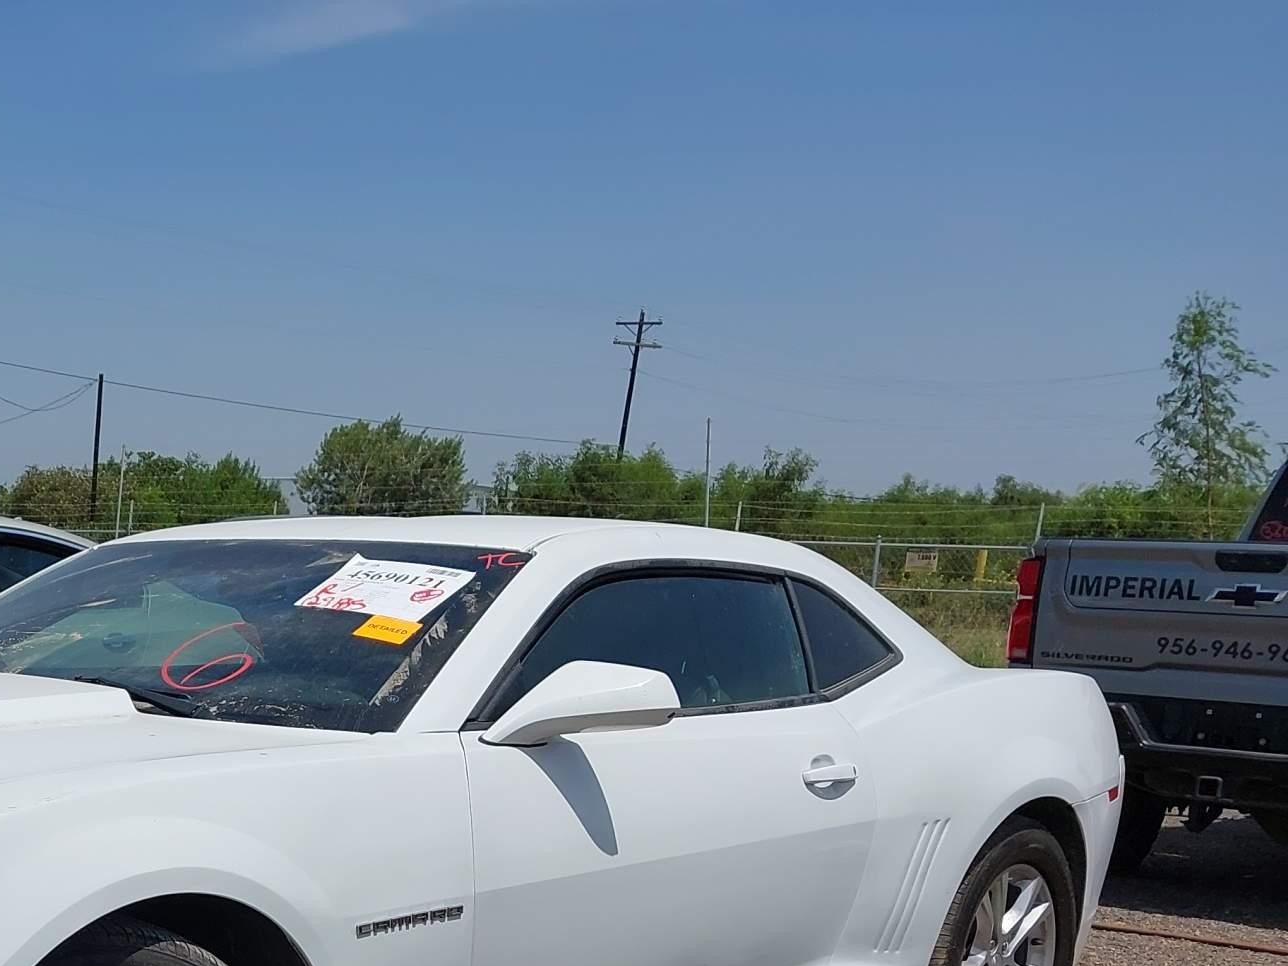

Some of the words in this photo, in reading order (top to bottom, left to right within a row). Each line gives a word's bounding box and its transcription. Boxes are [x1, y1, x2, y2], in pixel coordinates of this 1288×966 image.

[347, 568, 446, 589] 45690121
[1069, 574, 1201, 601] IMPERIAL
[367, 622, 409, 636] DETAILED
[1040, 650, 1134, 664] SILVERADO
[355, 905, 464, 940] CAMARO
